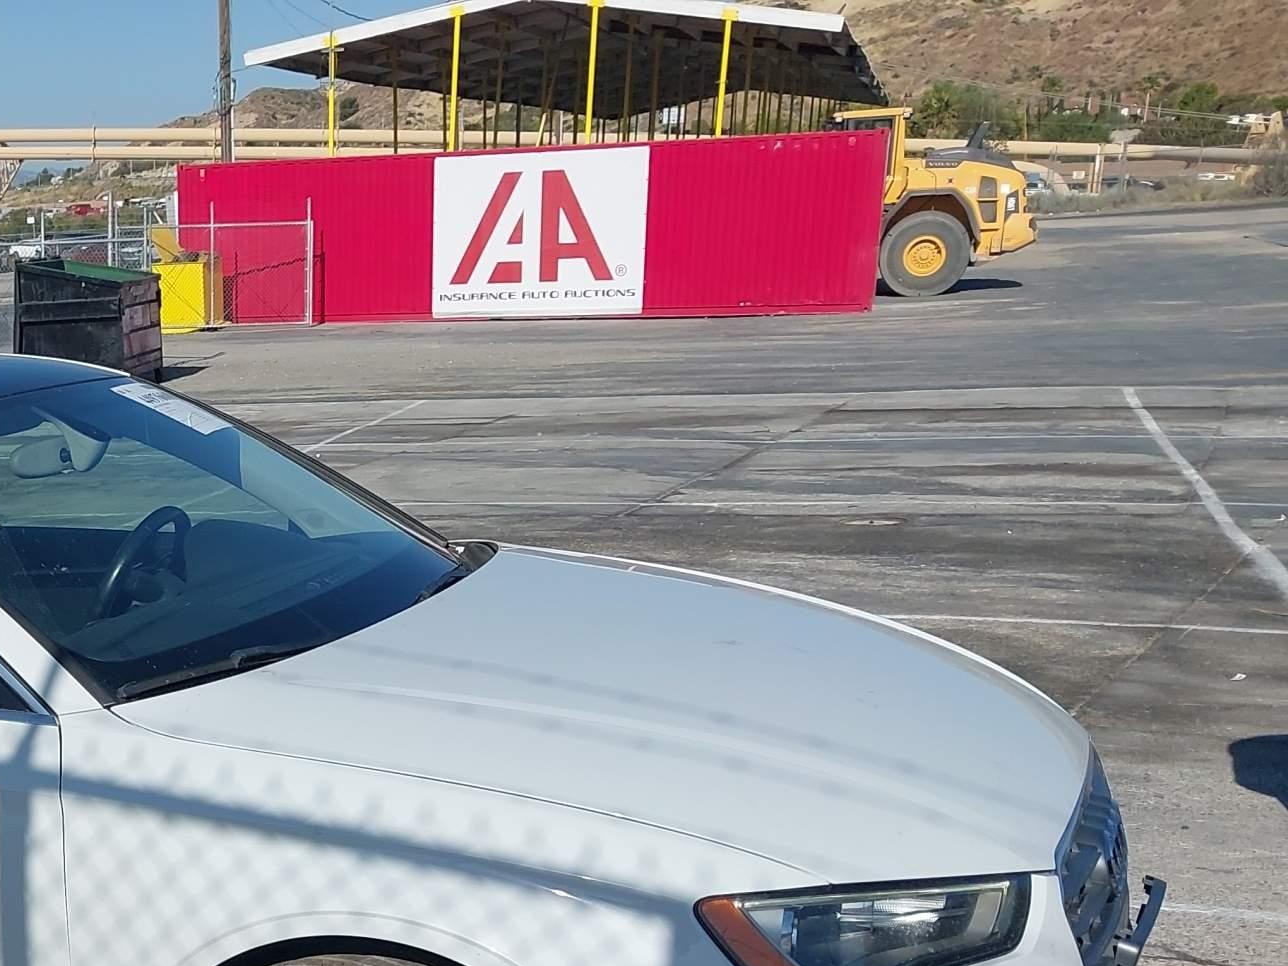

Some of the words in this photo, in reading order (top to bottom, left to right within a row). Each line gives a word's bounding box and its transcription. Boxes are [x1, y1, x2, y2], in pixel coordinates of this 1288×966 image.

[439, 292, 517, 302] INSURANCE
[522, 291, 560, 300] AUTO
[564, 288, 636, 299] AUCTIONS
